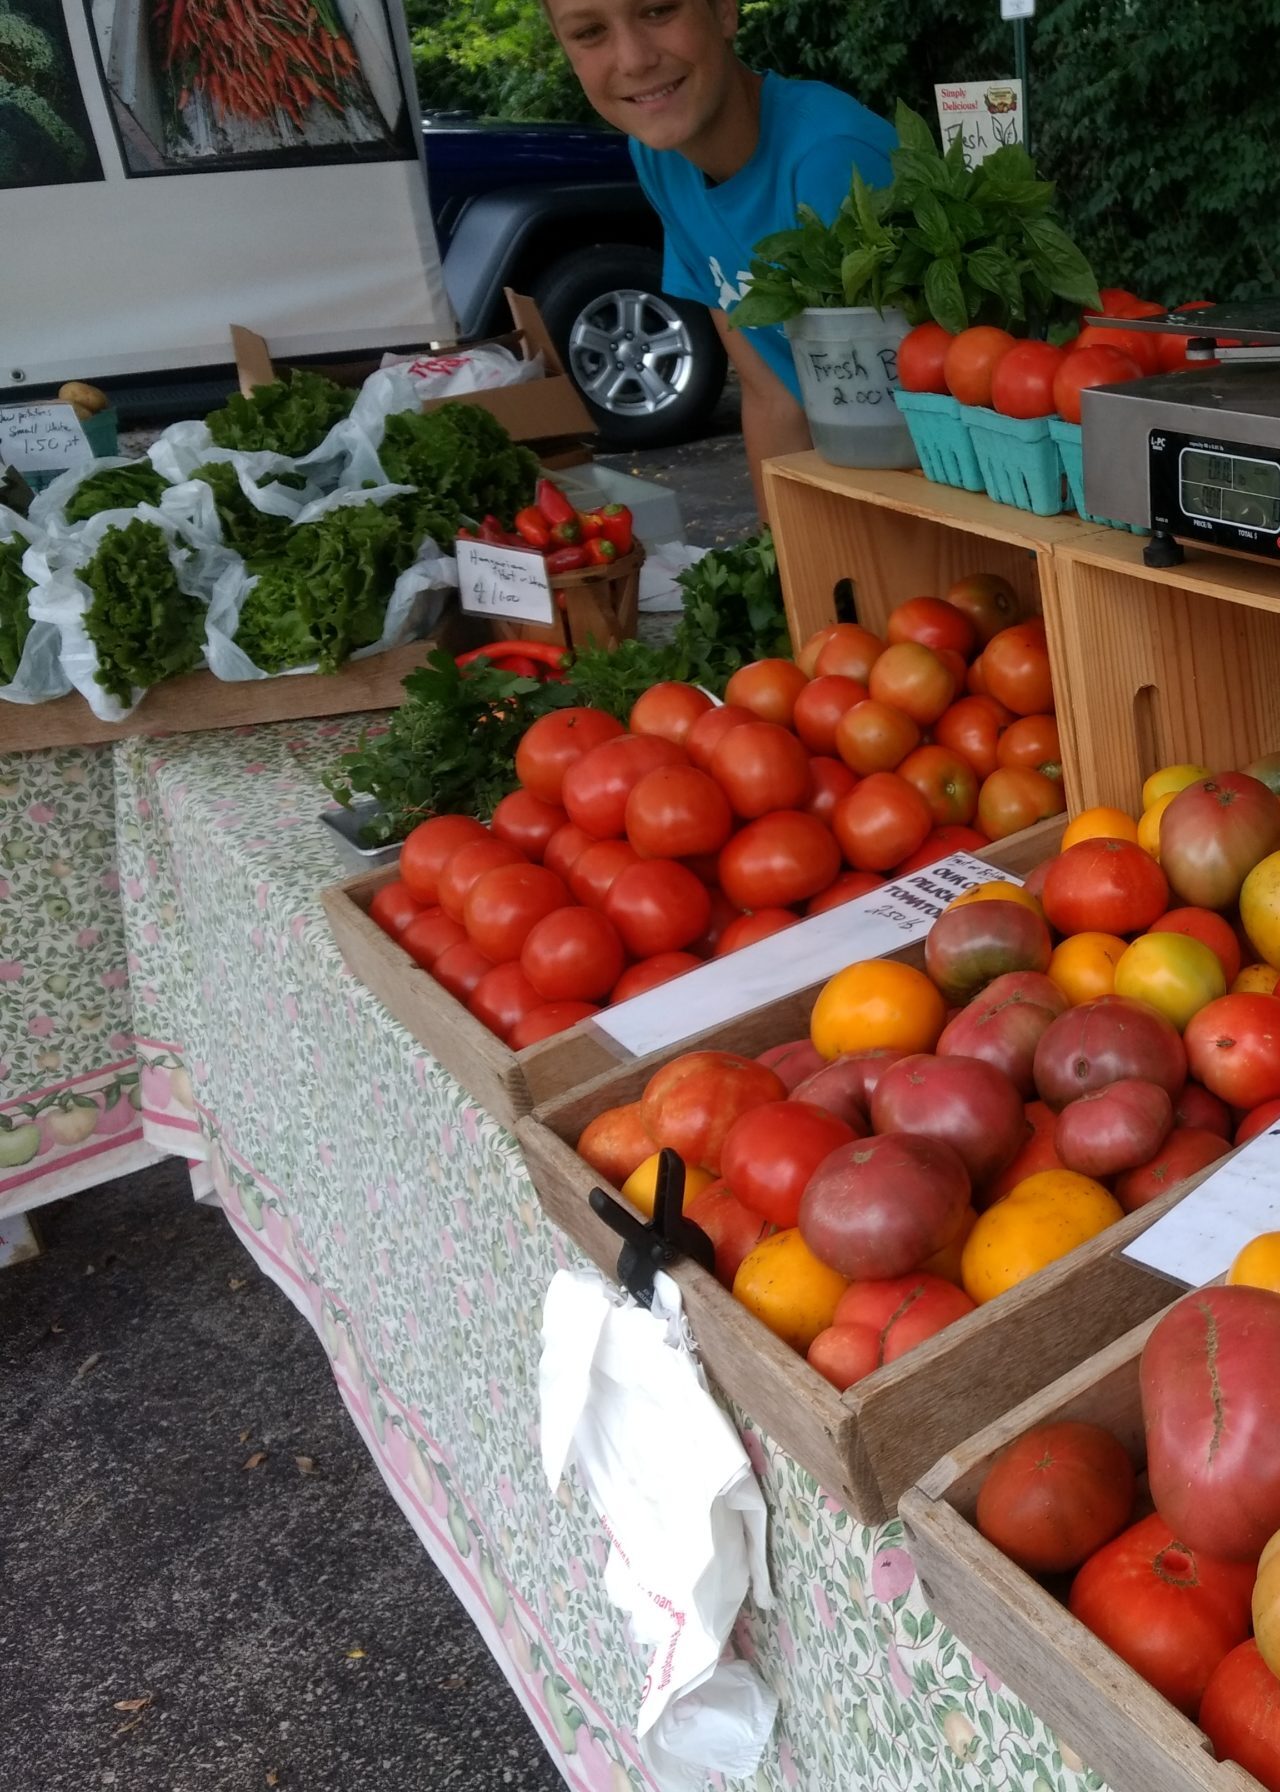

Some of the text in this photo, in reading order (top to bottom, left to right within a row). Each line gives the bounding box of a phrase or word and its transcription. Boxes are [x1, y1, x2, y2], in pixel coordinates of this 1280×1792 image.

[941, 88, 966, 98] Simply
[942, 100, 978, 110] Delicious!
[944, 120, 988, 149] Fesh
[808, 349, 869, 382] Fresh
[833, 386, 882, 406] 2.00
[9, 423, 38, 438] Small
[24, 435, 80, 455] 1.50 pt
[1238, 529, 1254, 539] TOTAL
[932, 867, 968, 886] OUR
